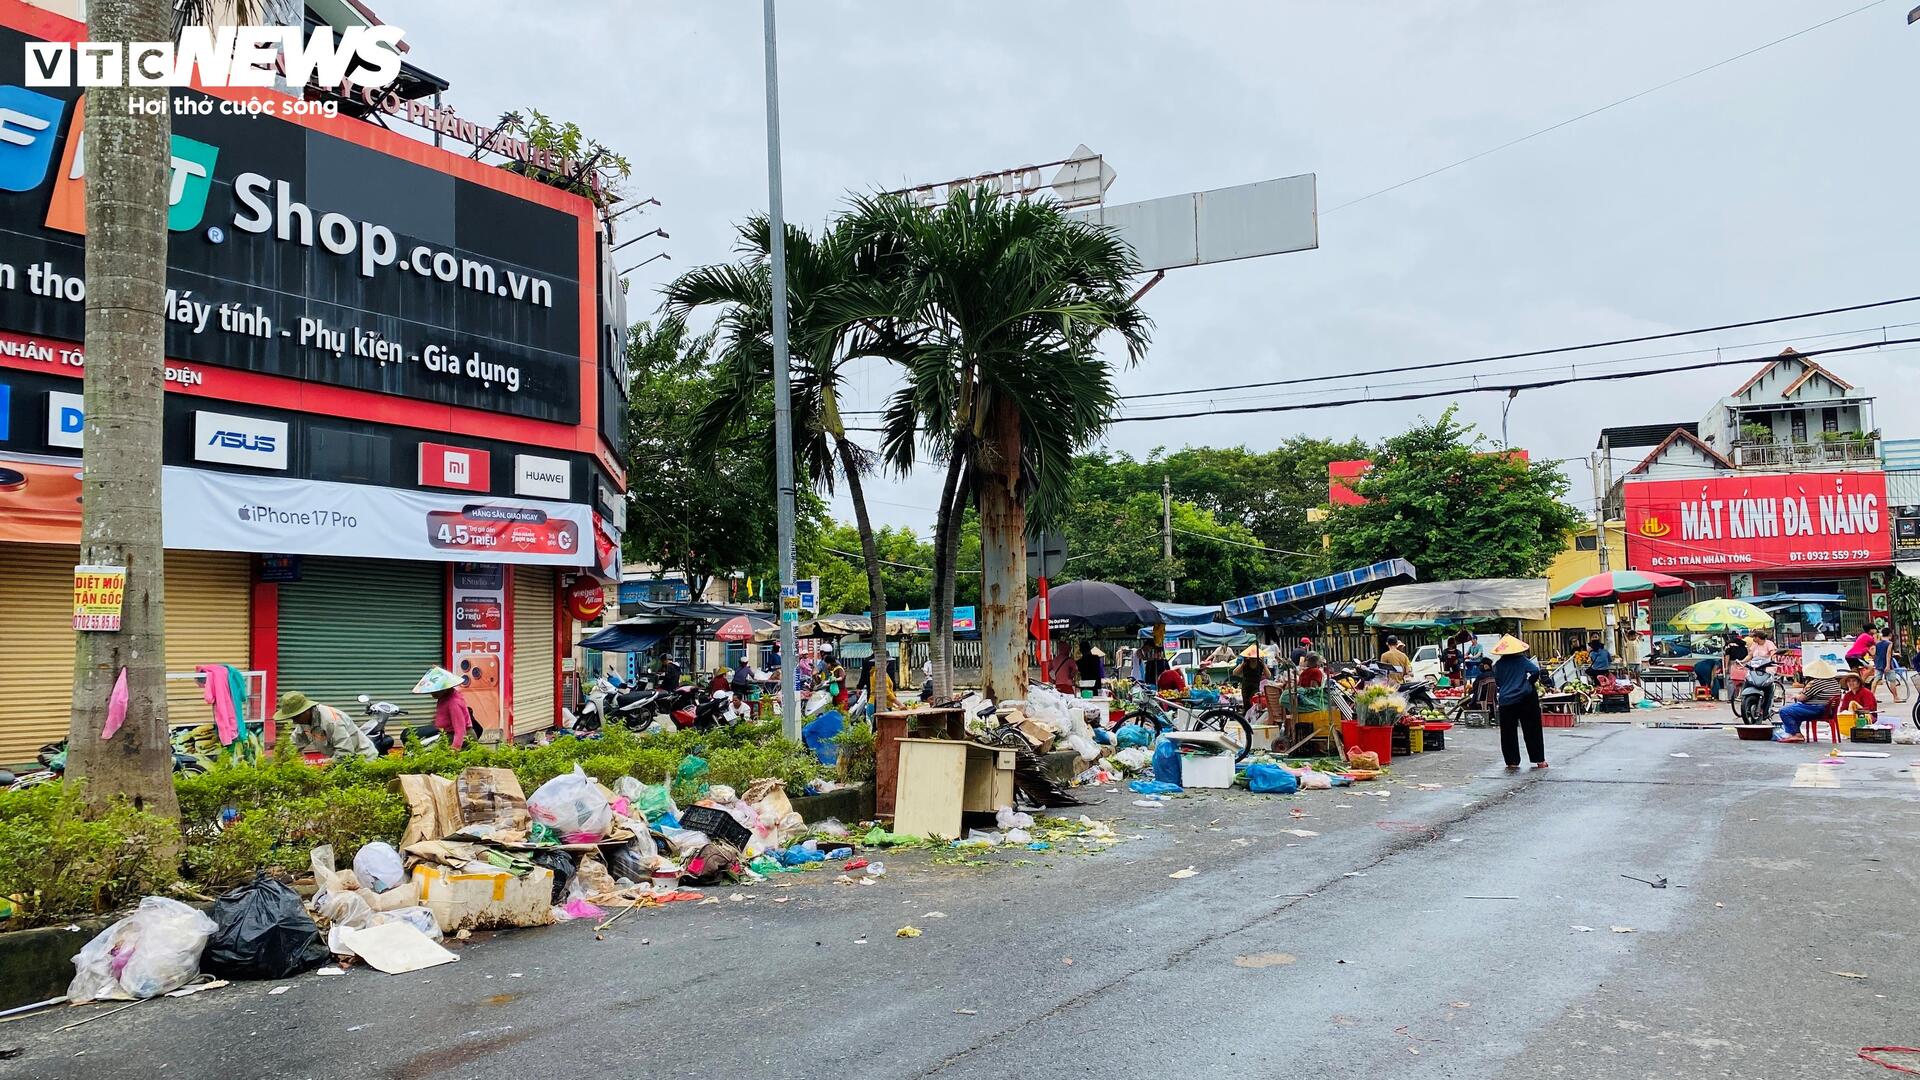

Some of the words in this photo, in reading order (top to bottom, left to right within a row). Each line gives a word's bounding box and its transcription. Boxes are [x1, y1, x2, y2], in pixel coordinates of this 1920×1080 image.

[164, 288, 211, 334] Máy
[218, 303, 272, 339] tính
[300, 316, 346, 359] Phụ
[423, 344, 460, 375] Gia
[465, 351, 520, 393] dụng
[164, 366, 202, 387] ĐIỆN
[208, 430, 276, 453] ASUS
[525, 470, 564, 484] HUAWEI
[251, 505, 310, 526] iPhone
[312, 510, 329, 526] 17
[332, 511, 357, 528] Pro
[472, 508, 491, 518] HÀNG
[507, 512, 521, 520] GIAO
[522, 513, 538, 521] NGAY
[1680, 485, 1723, 541] MẮT
[1728, 488, 1779, 539] KÍNH
[1783, 486, 1814, 537] ĐÀ
[1819, 477, 1880, 536] NẴNG
[437, 523, 469, 545] 4.5
[470, 533, 497, 549] TRIỆU
[1651, 556, 1667, 566] ĐC:
[1667, 556, 1677, 565] 31
[1808, 550, 1829, 561] 0932
[1832, 550, 1849, 560] 559
[1852, 549, 1870, 559] 799
[75, 575, 100, 591] DIỆT
[102, 573, 124, 590] MỐI
[74, 591, 97, 607] TẬN
[100, 590, 122, 605] GỐC
[456, 607, 464, 621] 8
[464, 612, 481, 622] TRIỆU
[456, 641, 501, 654] PRO
